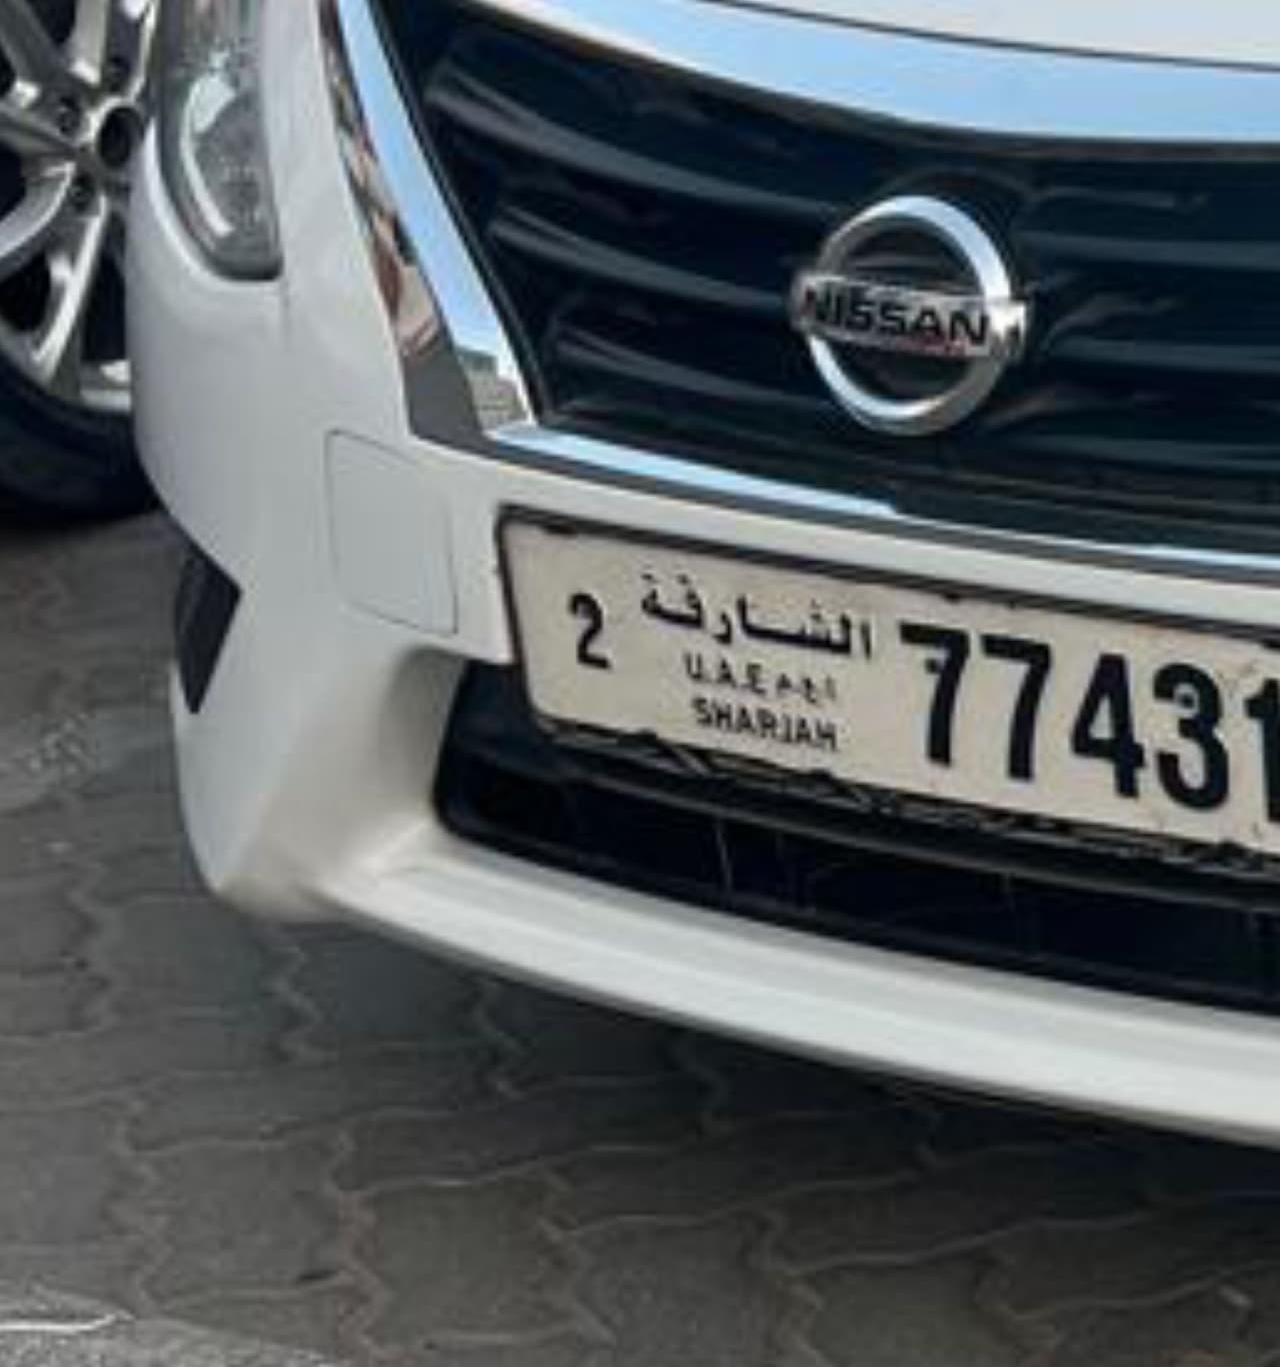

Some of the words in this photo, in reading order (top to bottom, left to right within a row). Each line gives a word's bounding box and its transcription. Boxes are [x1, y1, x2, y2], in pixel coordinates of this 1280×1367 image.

[803, 283, 992, 347] NISSAN
[568, 591, 613, 671] 2
[640, 572, 872, 661] الشارقة
[691, 695, 839, 754] SHARJAH
